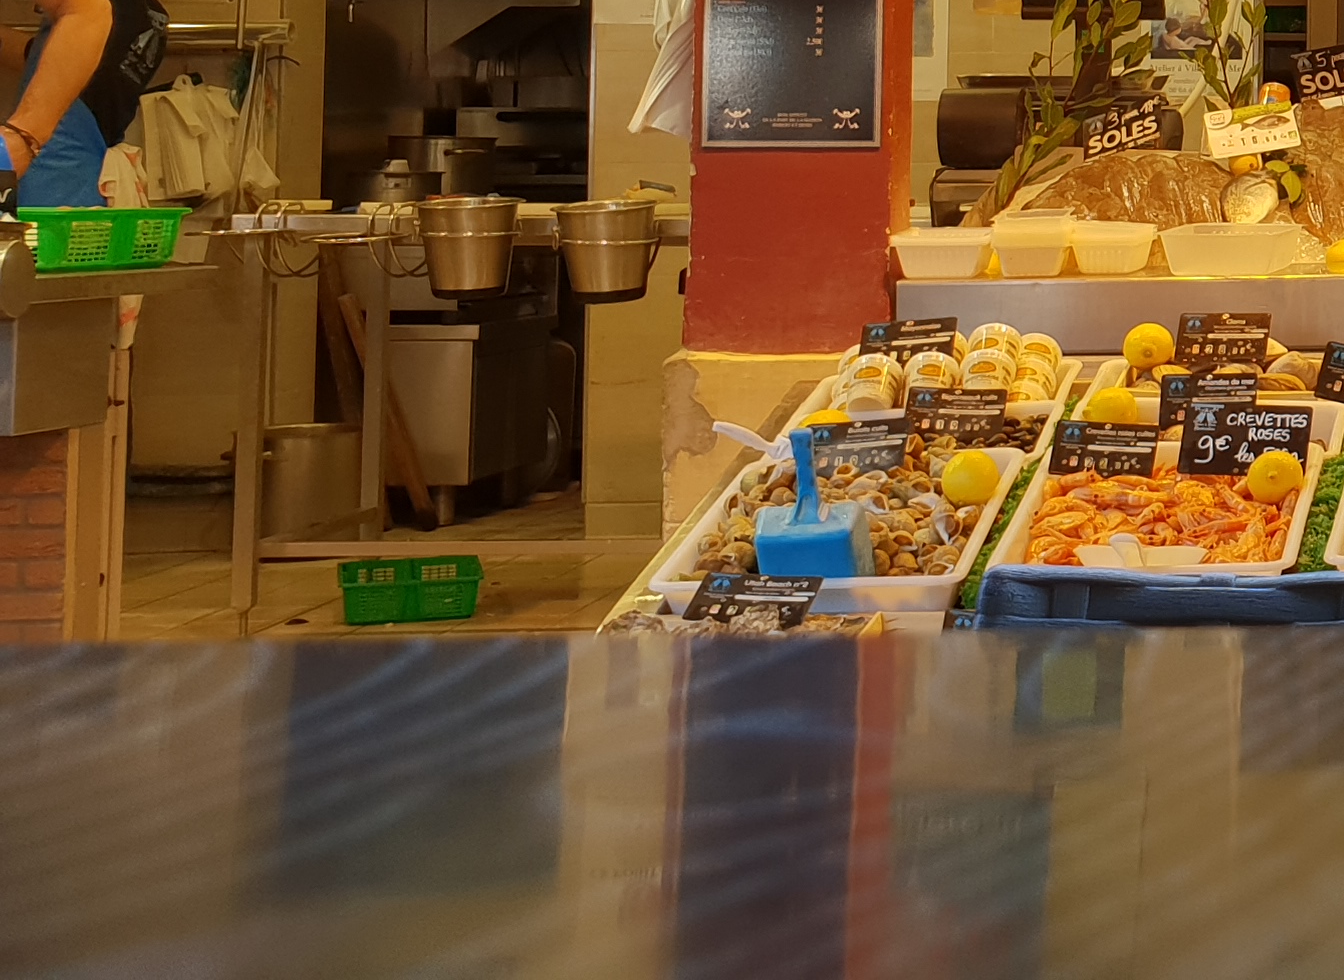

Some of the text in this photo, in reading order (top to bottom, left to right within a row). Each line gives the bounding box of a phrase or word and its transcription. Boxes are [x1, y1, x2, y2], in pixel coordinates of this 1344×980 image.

[1315, 51, 1327, 67] 5
[1088, 116, 1158, 154] SOLES
[1226, 412, 1308, 428] CREVETTES
[1086, 427, 1117, 437] Crevettes
[1135, 430, 1156, 438] cuites
[1248, 428, 1291, 442] ROSES
[1193, 434, 1232, 464] 9€
